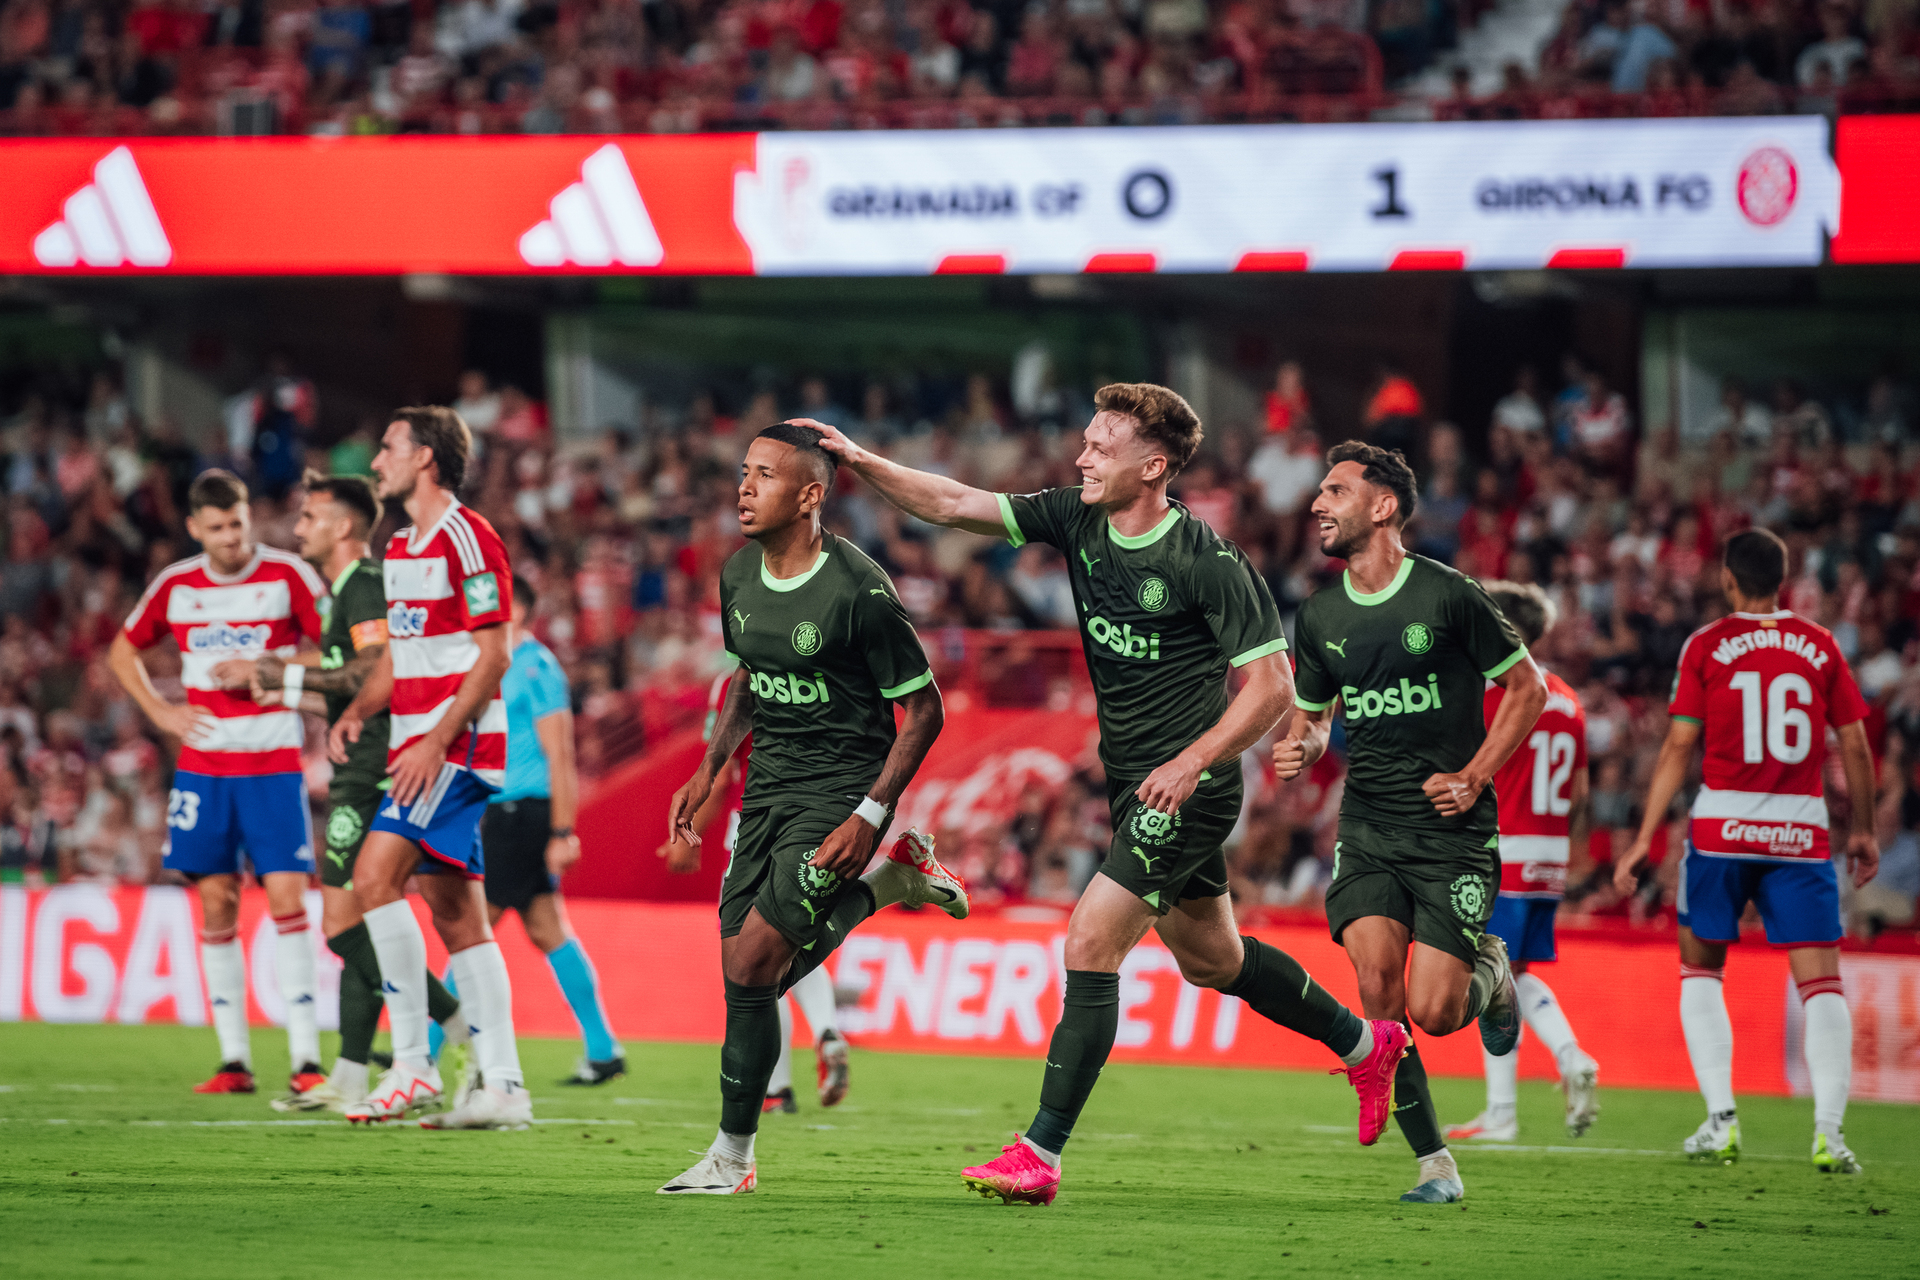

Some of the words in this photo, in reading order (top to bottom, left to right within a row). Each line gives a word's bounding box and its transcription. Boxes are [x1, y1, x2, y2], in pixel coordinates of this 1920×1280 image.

[1370, 169, 1408, 218] 1
[1476, 177, 1641, 213] GIRONA
[1085, 608, 1160, 660] osbi
[1712, 629, 1781, 665] VÍCTOR
[1784, 632, 1829, 671] DÍAZ
[1341, 673, 1442, 720] Gosbi
[1729, 671, 1813, 765] 16
[1528, 730, 1576, 816] 12
[1141, 837, 1152, 845] de
[1154, 830, 1178, 846] Girona
[1721, 820, 1813, 850] Greening
[797, 862, 810, 892] Pirineu
